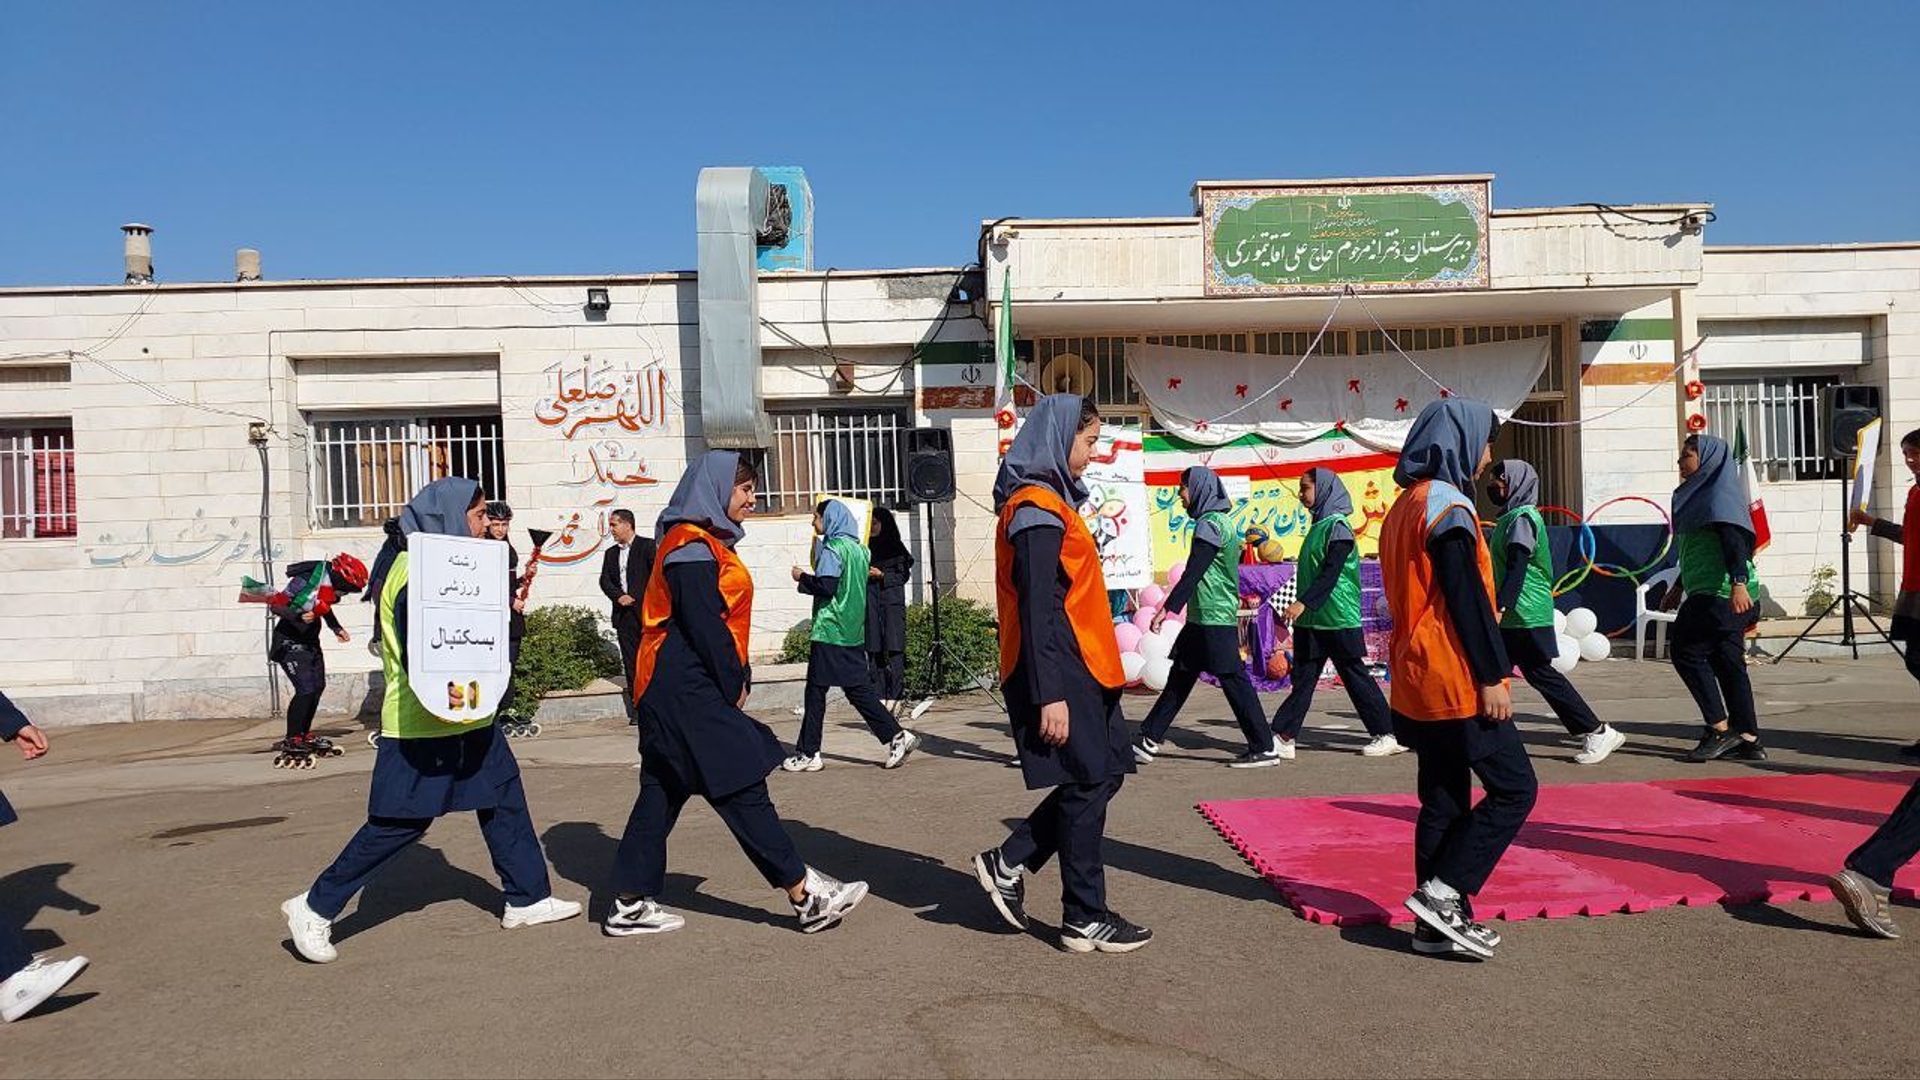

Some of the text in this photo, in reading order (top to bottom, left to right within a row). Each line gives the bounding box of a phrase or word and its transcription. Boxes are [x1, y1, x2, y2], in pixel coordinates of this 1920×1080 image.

[1285, 242, 1308, 272] علی
[1308, 242, 1334, 271] حاج
[1337, 240, 1371, 274] مرحوم
[1368, 228, 1401, 264] دخترانه
[1403, 230, 1472, 263] دبیرستان
[448, 554, 477, 570] رشته
[439, 580, 480, 596] ورزشی
[431, 627, 495, 650] بسکتبال
